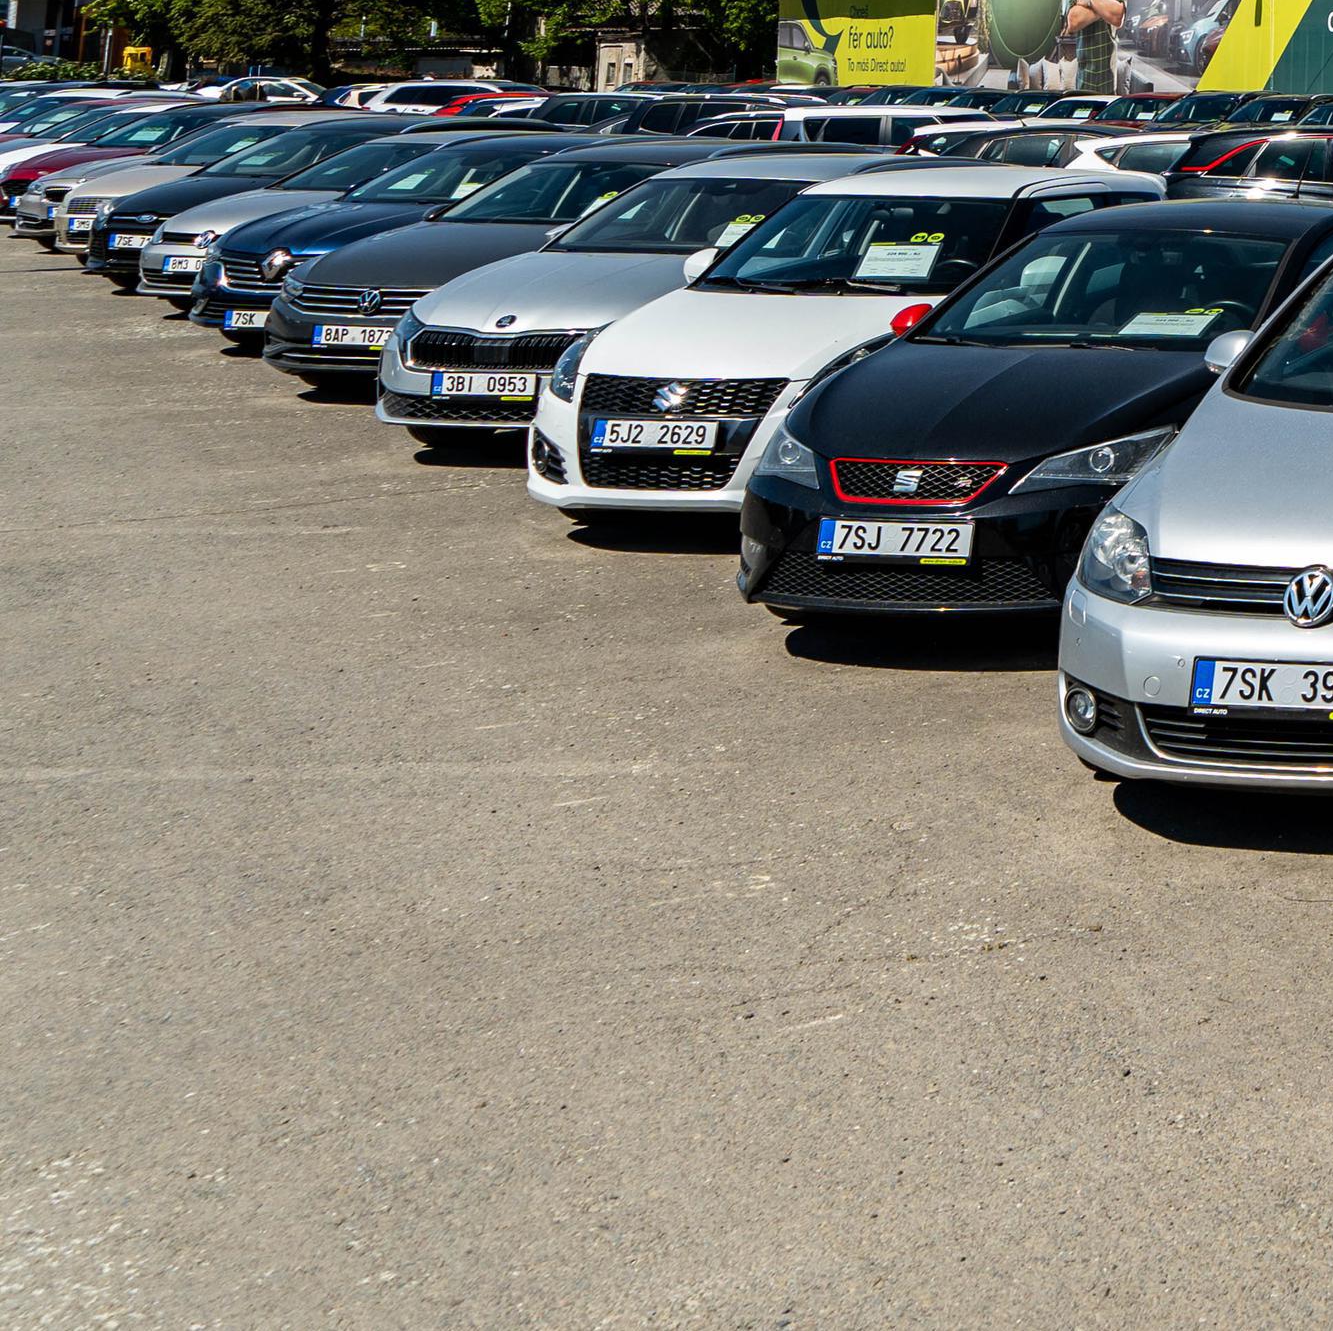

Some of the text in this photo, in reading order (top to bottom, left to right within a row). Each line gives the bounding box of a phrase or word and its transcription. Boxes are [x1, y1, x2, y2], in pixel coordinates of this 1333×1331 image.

[848, 25, 894, 49] fér auto?
[847, 58, 855, 71] To
[856, 58, 869, 71] máš
[870, 58, 889, 72] Direct
[117, 236, 133, 246] 7SE
[235, 312, 256, 325] 7SK
[324, 328, 349, 343] 8AP
[446, 376, 527, 393] 3BI 0953
[608, 423, 707, 445] 5J2 2629
[820, 540, 832, 549] CZ
[838, 524, 960, 553] 7SJ 7722
[1219, 666, 1277, 703] 7SK
[1195, 688, 1210, 699] CZ
